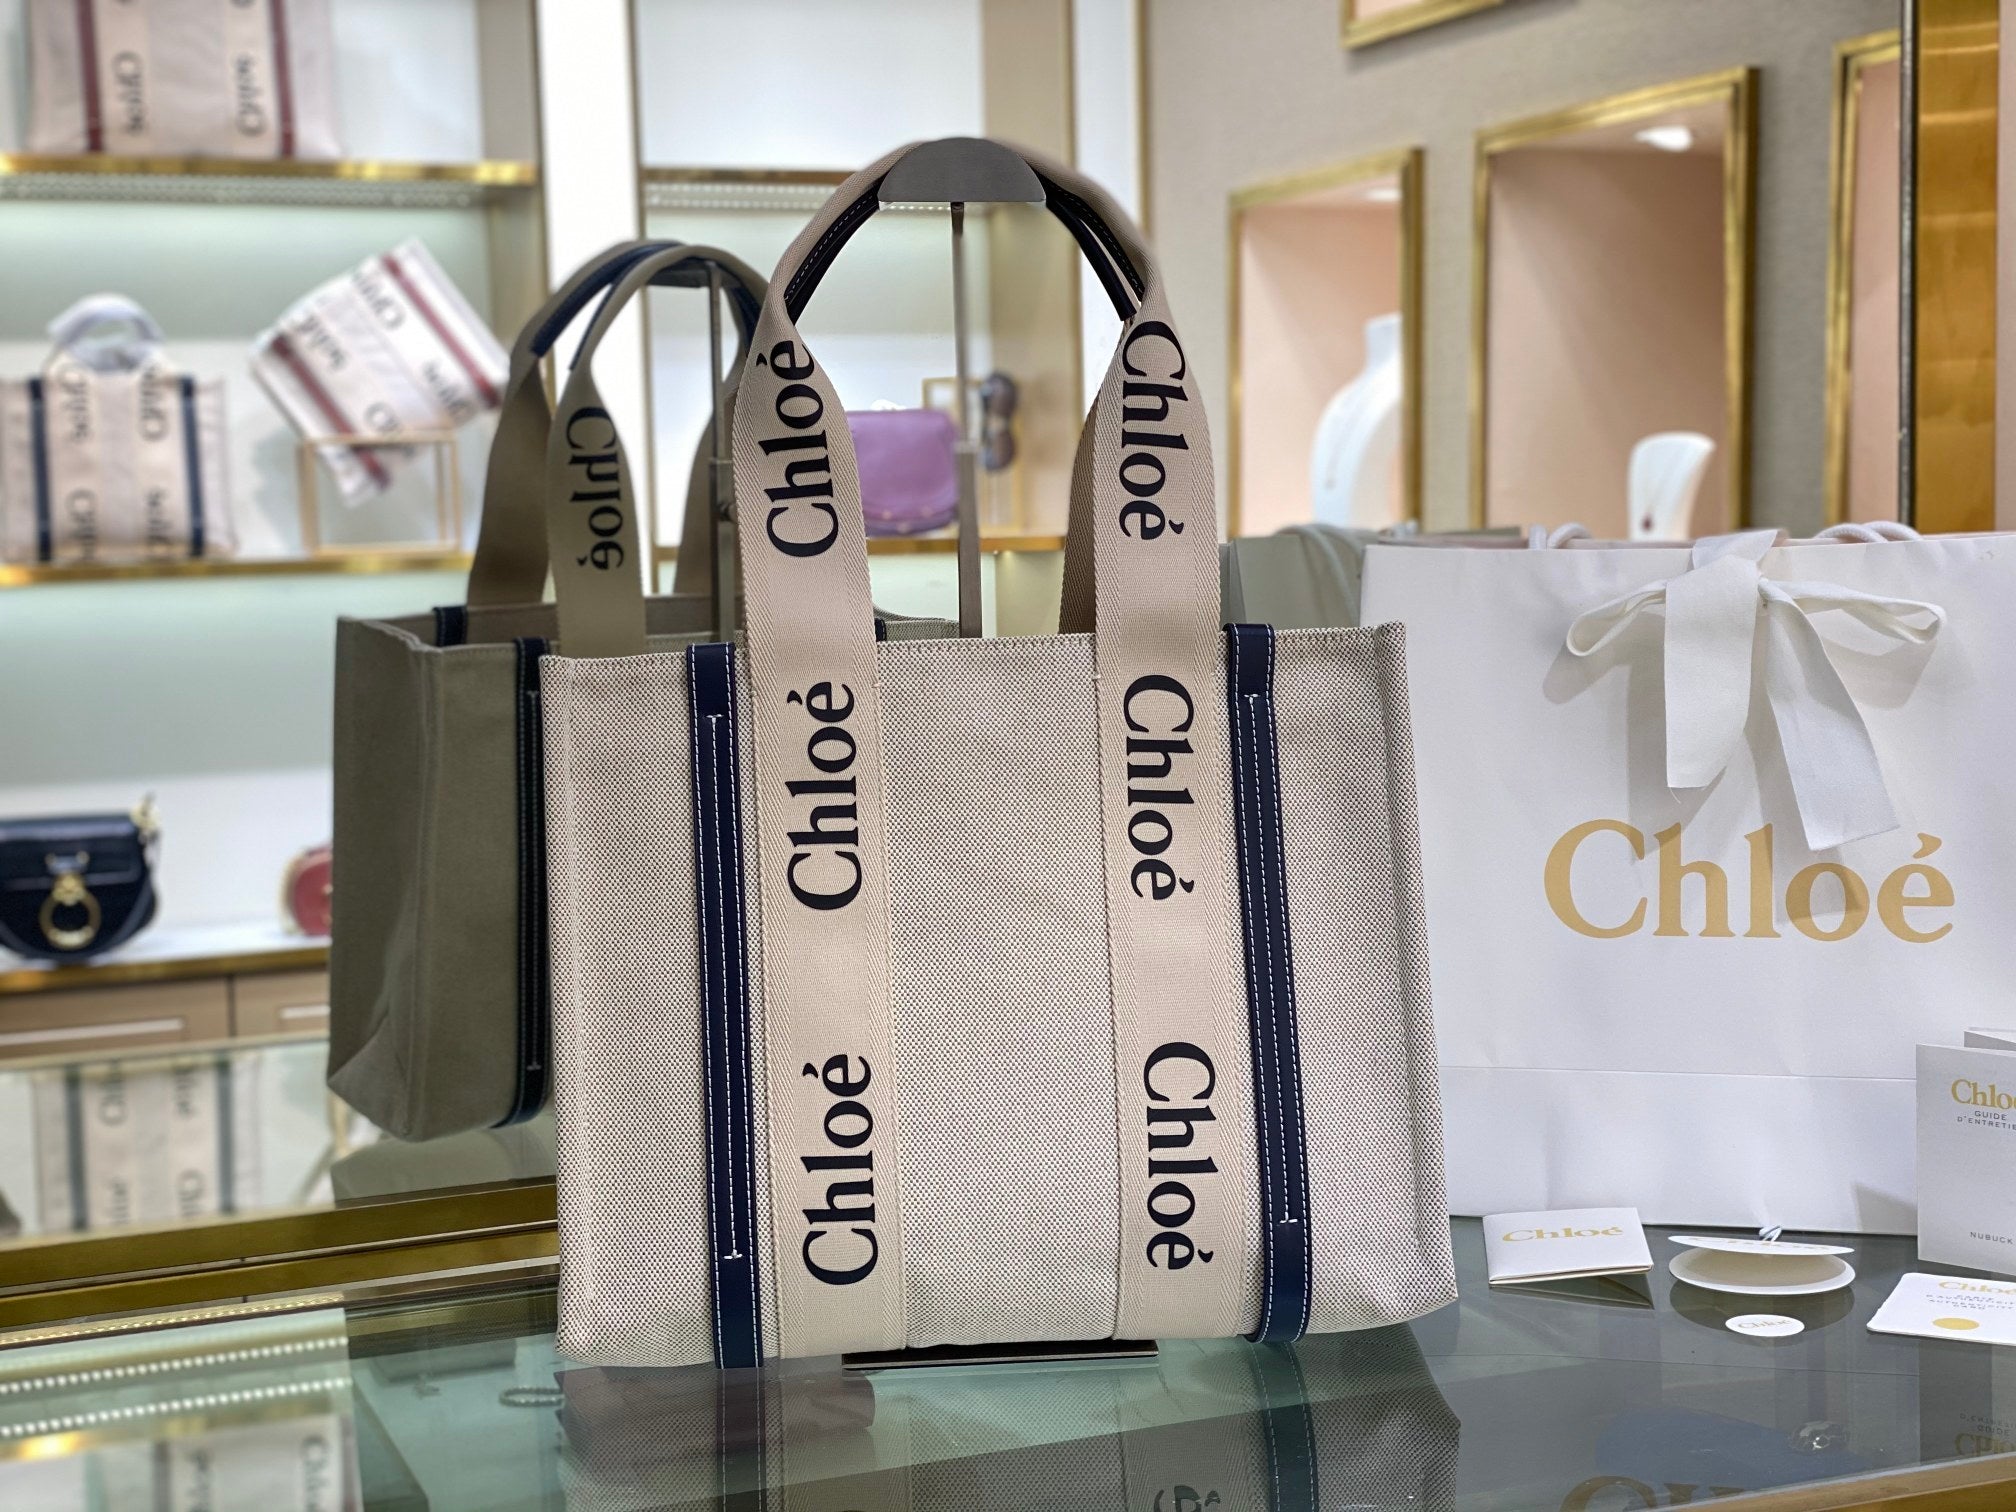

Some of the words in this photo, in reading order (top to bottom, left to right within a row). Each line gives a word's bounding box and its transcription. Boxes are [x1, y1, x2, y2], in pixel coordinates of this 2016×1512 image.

[756, 339, 840, 558] Chloé
[1118, 320, 1190, 541] Chloé
[787, 681, 863, 911] Chloé
[1123, 673, 1195, 901] Chloé
[1544, 818, 1956, 944] Chloé
[800, 1053, 879, 1286] Chloé
[1143, 1041, 1219, 1271] Chloé
[1974, 1110, 2008, 1121] GUIDE
[1502, 1226, 1624, 1242] Chloé
[1970, 1231, 2014, 1245] NUBUCK
